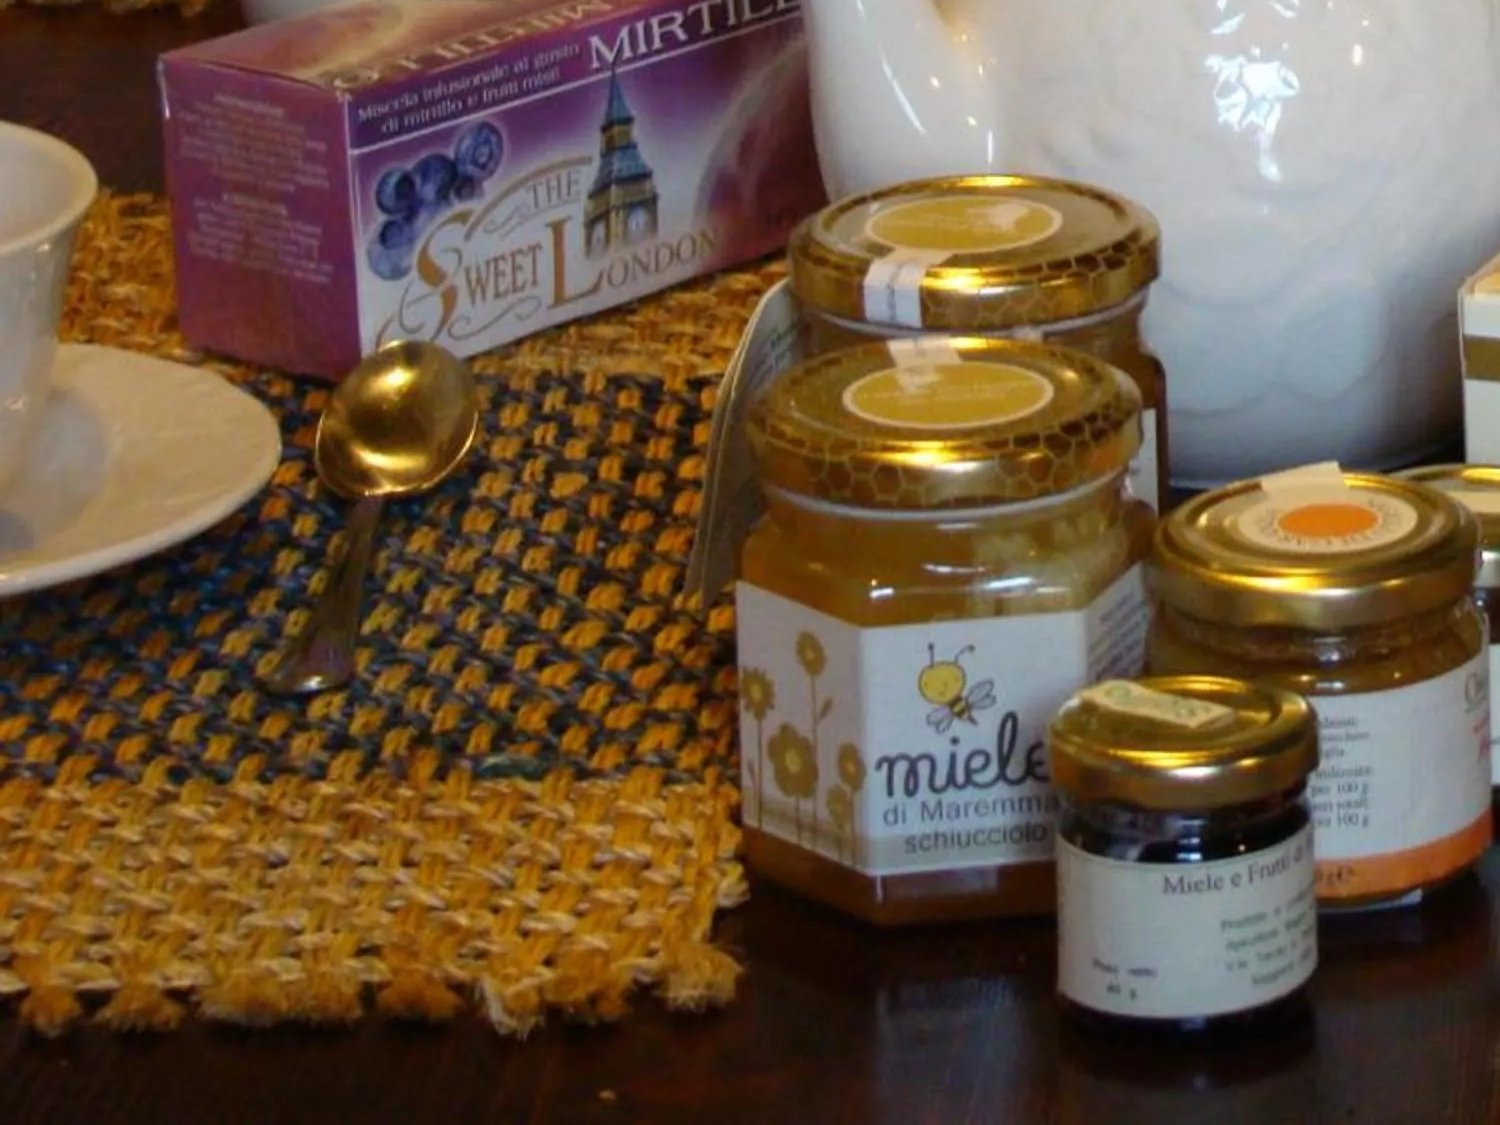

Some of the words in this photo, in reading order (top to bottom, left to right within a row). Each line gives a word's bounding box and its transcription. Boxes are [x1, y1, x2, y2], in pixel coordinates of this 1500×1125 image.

[527, 170, 584, 210] THE
[545, 215, 720, 311] LONDON
[875, 711, 1051, 799] miele
[883, 803, 908, 826] di
[1162, 874, 1225, 896] Miele
[1229, 872, 1243, 888] e
